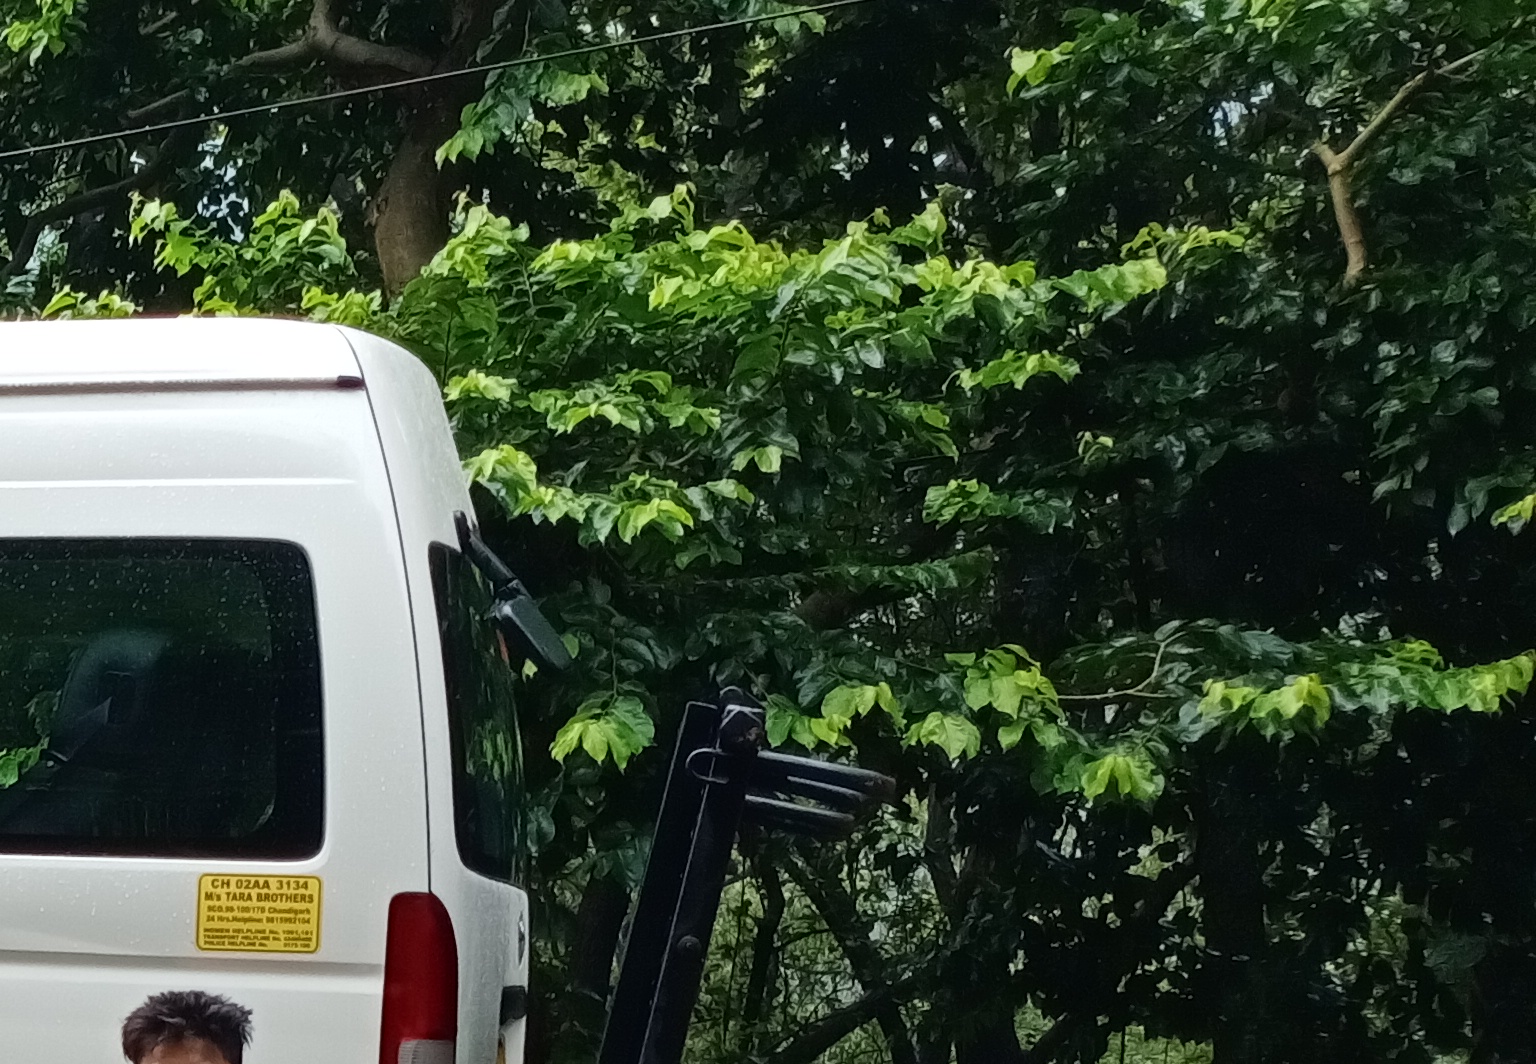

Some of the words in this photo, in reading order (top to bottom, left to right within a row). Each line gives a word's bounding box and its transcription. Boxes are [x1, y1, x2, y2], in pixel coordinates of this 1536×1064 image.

[211, 878, 231, 890] CH
[235, 878, 271, 891] 02AA
[275, 880, 309, 892] 3134
[225, 892, 253, 903] TARA
[256, 892, 314, 904] BROTHERS
[268, 906, 311, 916] Chandigarh
